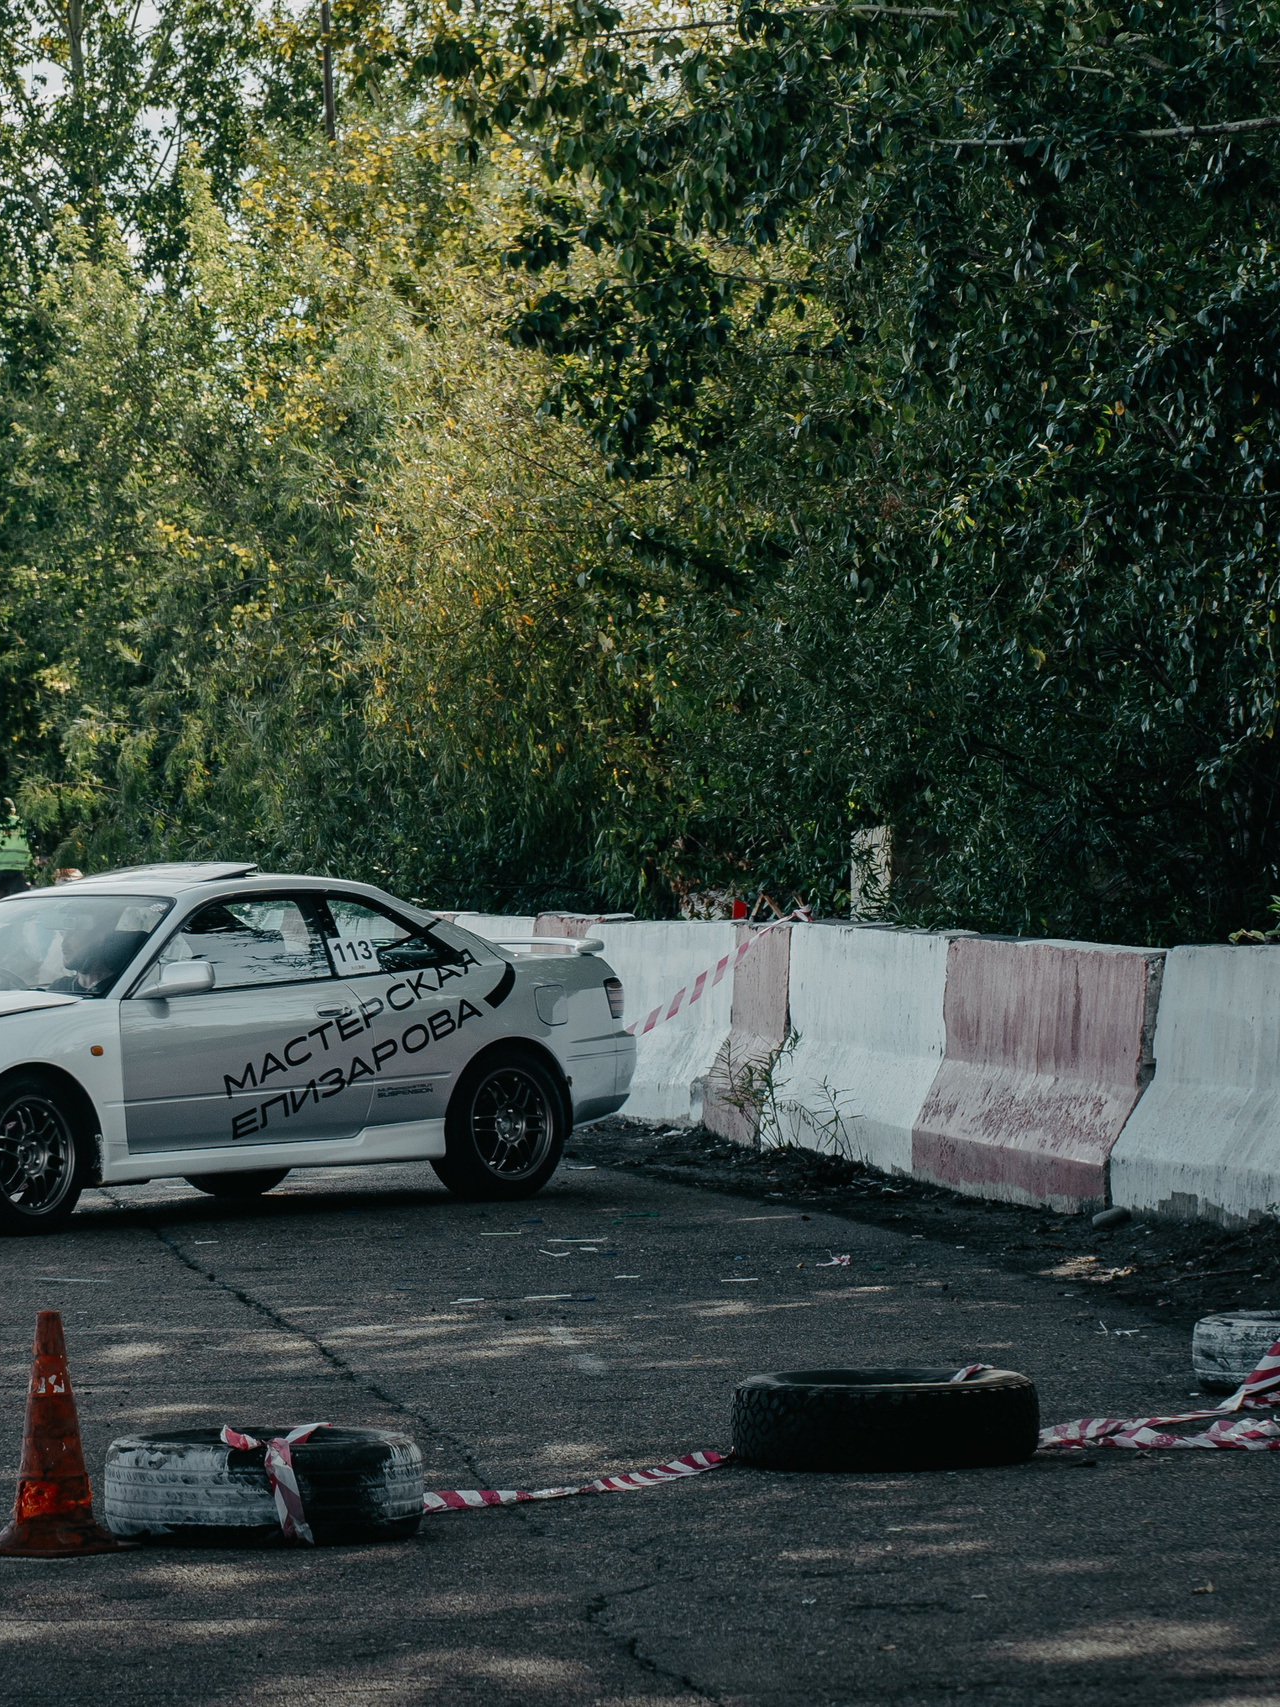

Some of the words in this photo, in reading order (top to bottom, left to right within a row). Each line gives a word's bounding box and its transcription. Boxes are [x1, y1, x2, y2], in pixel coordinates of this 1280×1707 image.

[333, 940, 373, 962] 113
[223, 948, 482, 1099] МАСТЕРСКАЯ
[231, 998, 484, 1141] ЕЛИЗАРОВА
[377, 1087, 433, 1098] SUSPENSION
